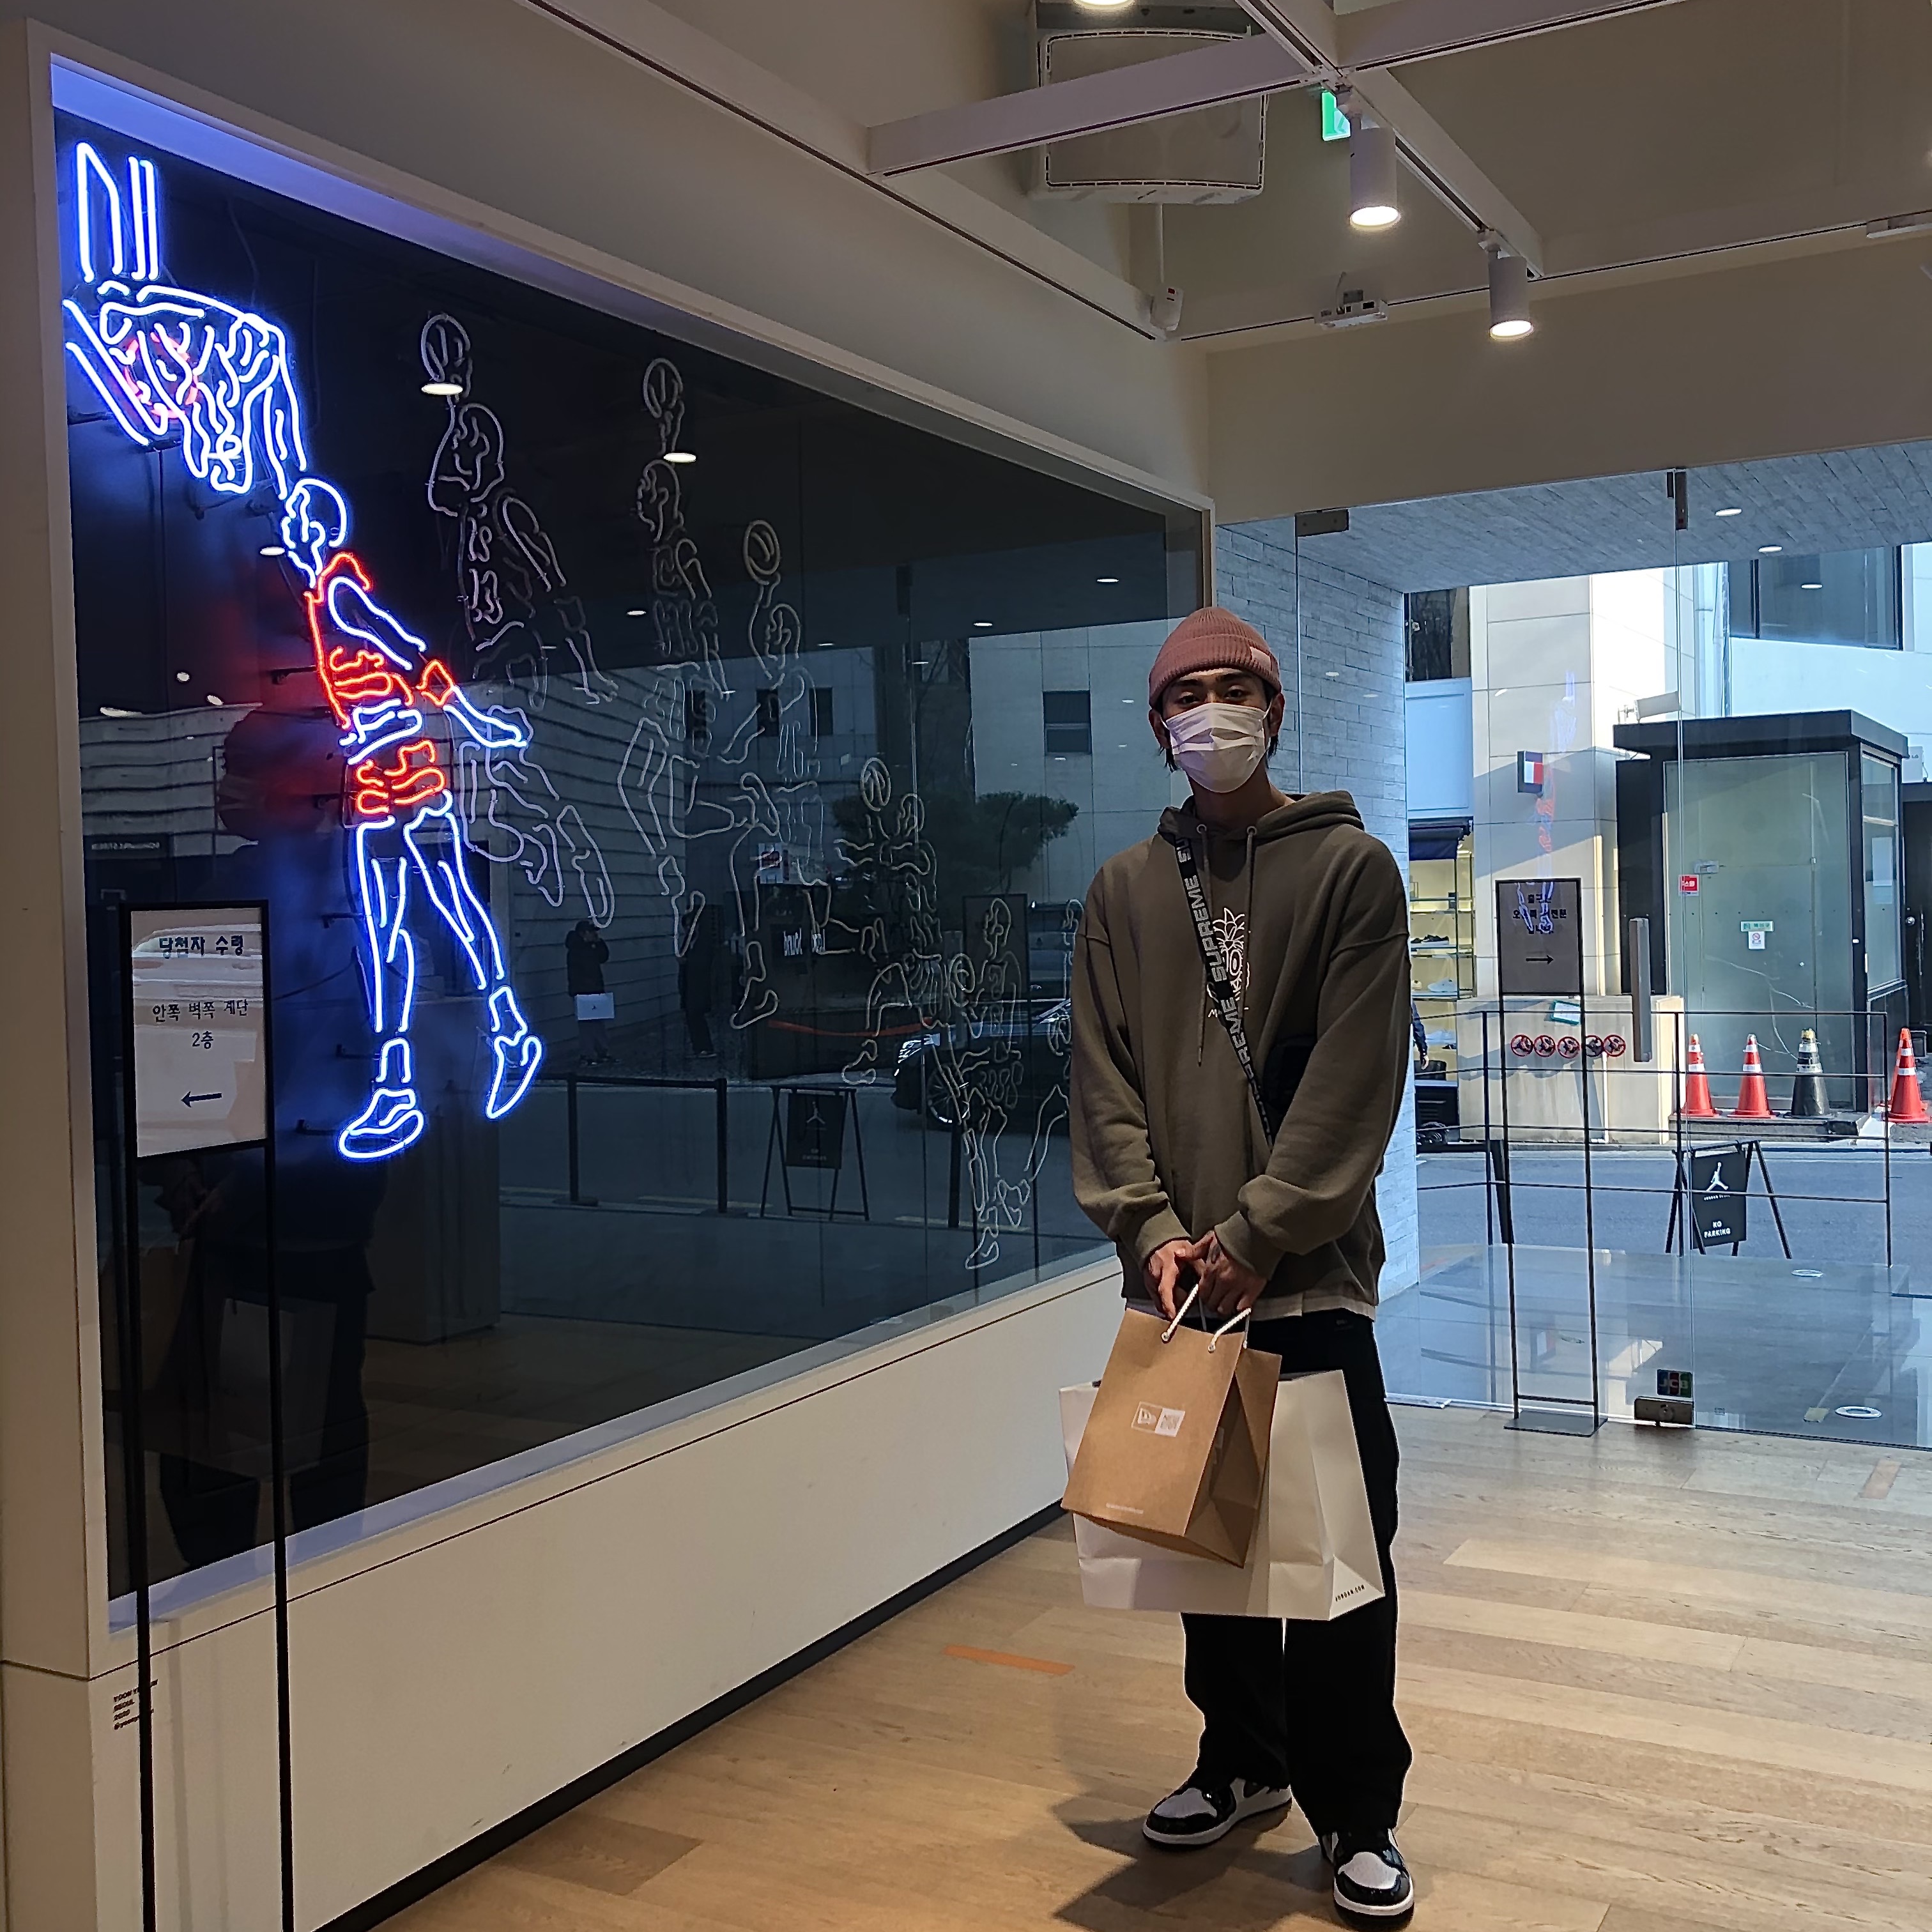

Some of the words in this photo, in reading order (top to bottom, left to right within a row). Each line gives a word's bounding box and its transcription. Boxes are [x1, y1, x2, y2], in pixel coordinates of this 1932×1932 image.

[1184, 875, 1228, 982] SUPREME
[159, 936, 206, 959] 당첨자
[215, 935, 244, 956] 수령
[152, 1004, 181, 1023] 안쪽
[188, 1001, 216, 1020] 벽쪽
[224, 999, 249, 1016] 계단
[192, 1031, 214, 1050] 2층
[1704, 1227, 1731, 1239] PARKING
[1712, 1220, 1722, 1229] NO
[1660, 1377, 1689, 1390] JCB
